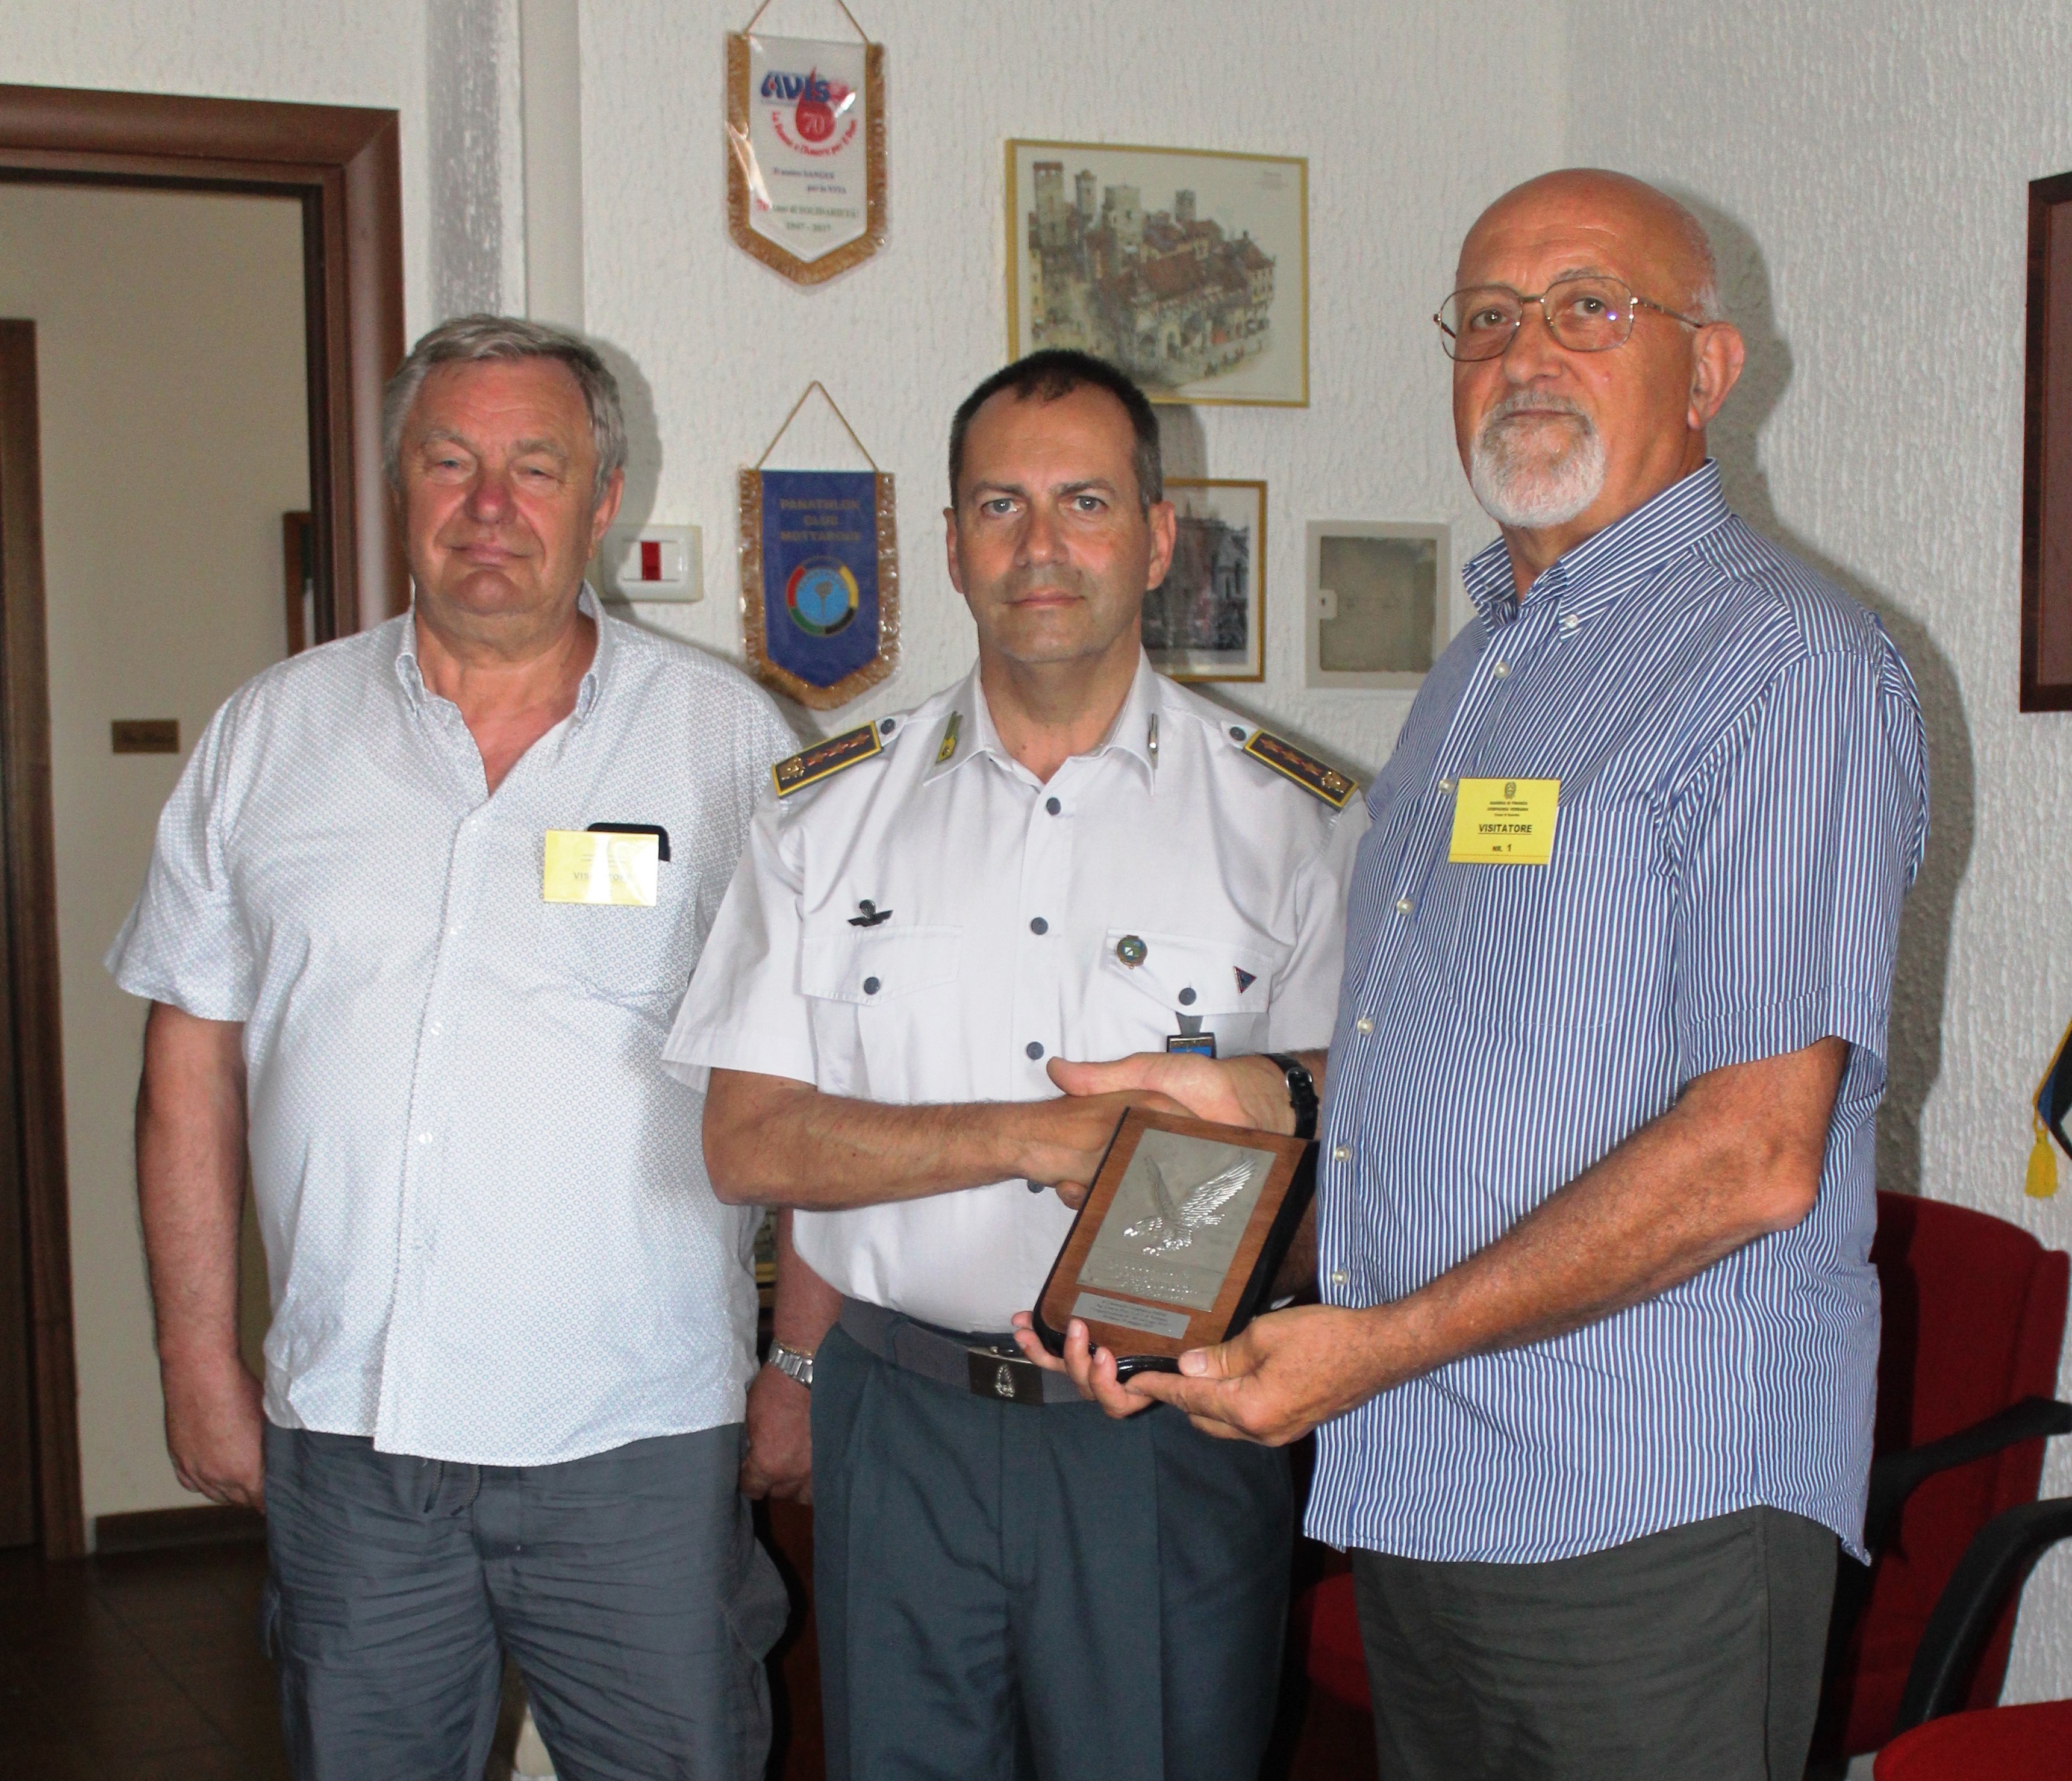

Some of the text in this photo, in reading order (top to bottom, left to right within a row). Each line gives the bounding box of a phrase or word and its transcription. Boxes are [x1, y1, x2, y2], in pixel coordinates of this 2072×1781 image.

[761, 72, 831, 103] AVIS
[802, 111, 826, 133] 70
[803, 515, 838, 526] CLUB
[1479, 824, 1532, 833] VISITATORE
